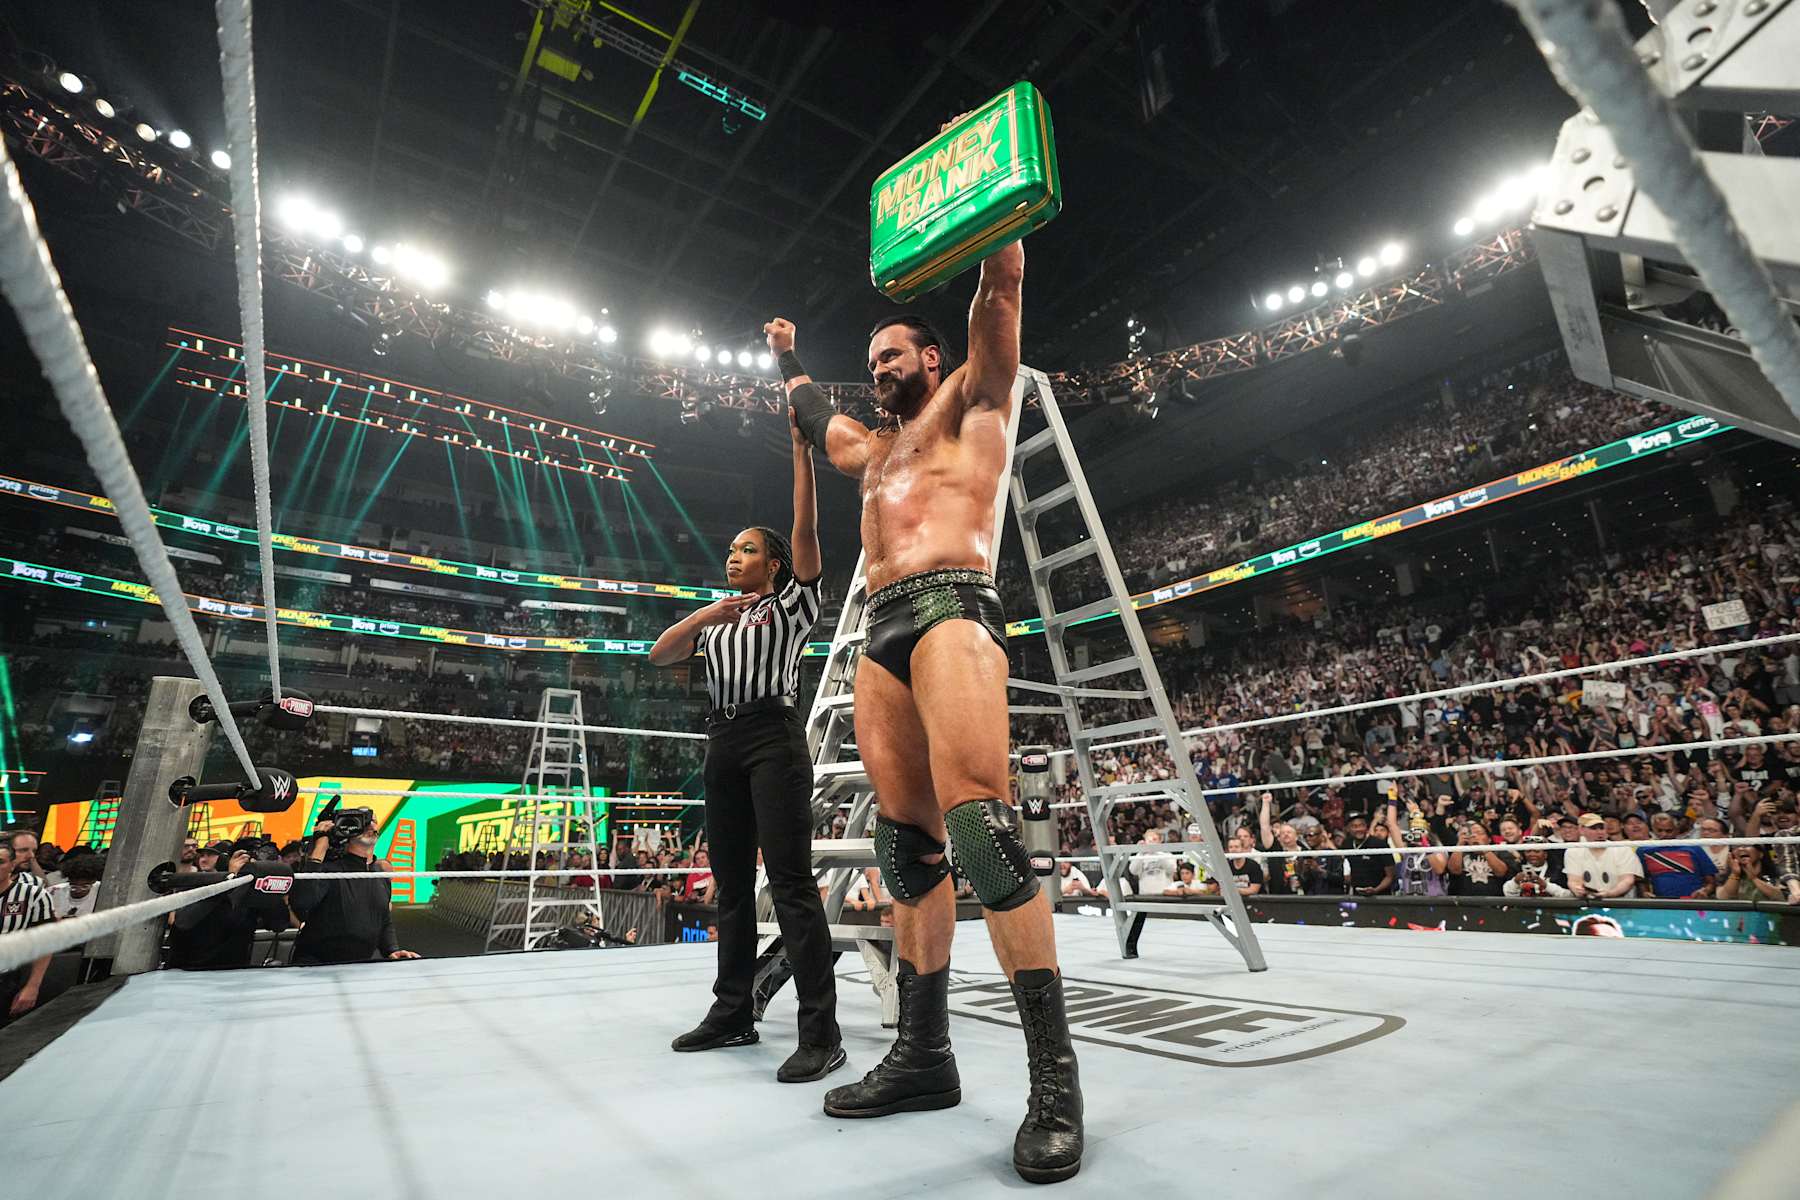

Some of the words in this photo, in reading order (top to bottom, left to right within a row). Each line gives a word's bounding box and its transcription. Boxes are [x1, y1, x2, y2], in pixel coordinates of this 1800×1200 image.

[877, 109, 1003, 219] MONEY
[896, 139, 1002, 231] BANK
[1518, 463, 1561, 486] MONEY
[1559, 458, 1597, 480] BANK
[53, 571, 83, 583] prime
[289, 700, 309, 714] PRIME
[266, 879, 289, 892] PRIME
